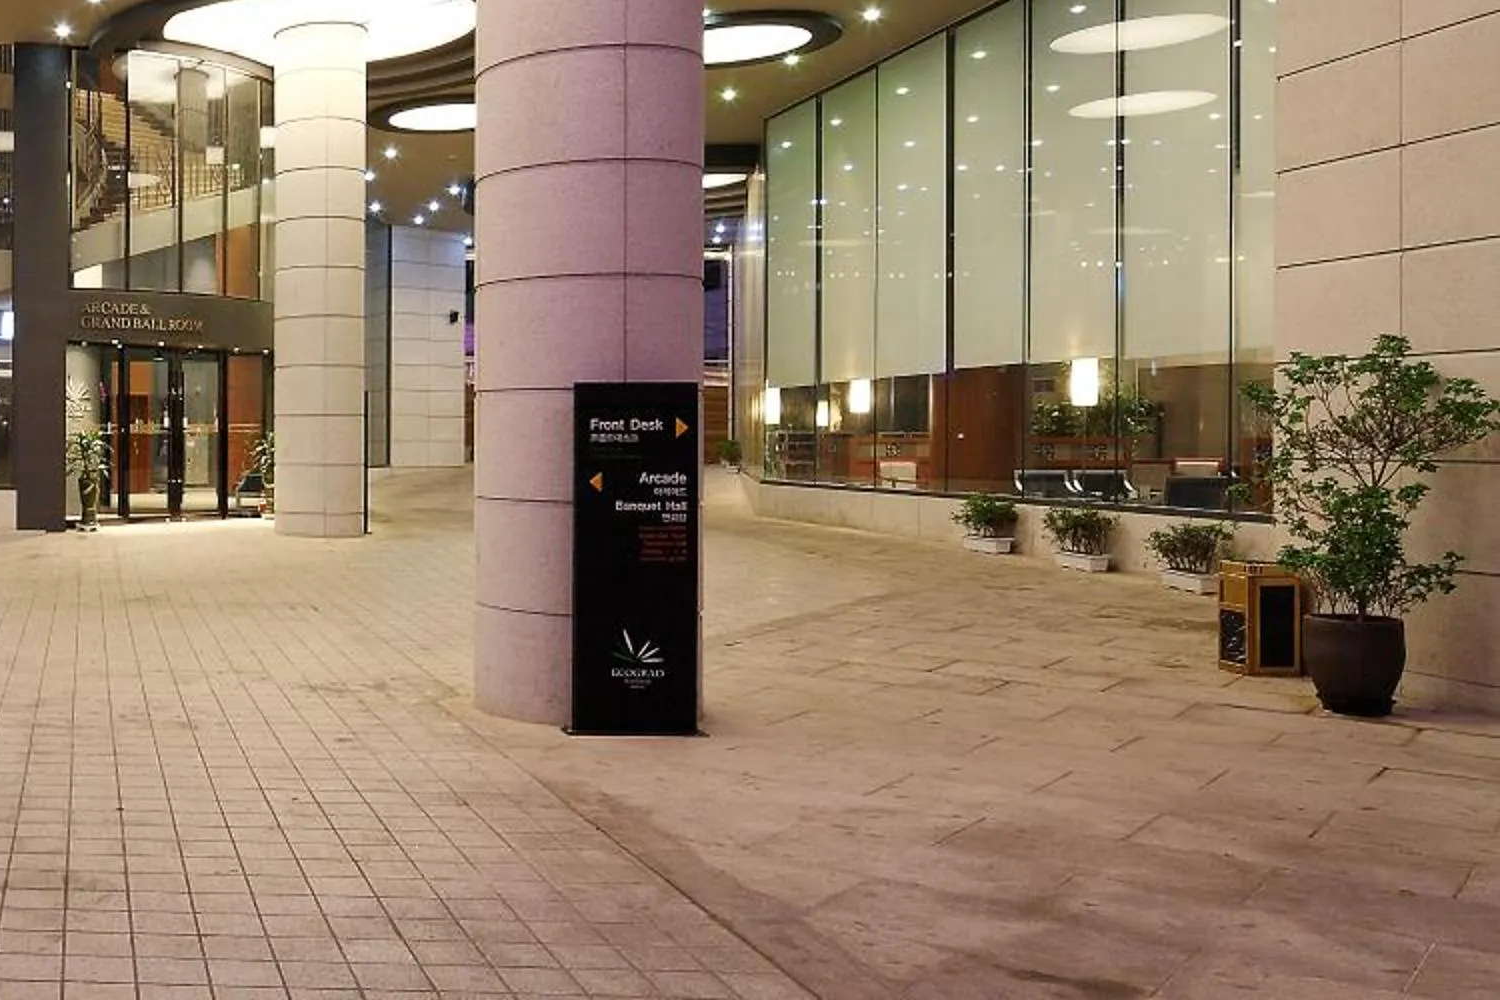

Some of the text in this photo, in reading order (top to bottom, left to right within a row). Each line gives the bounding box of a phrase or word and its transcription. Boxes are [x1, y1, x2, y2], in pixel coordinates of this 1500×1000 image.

[81, 301, 151, 316] ARCADE &
[81, 316, 131, 329] GRAND
[590, 418, 664, 431] Front Desk
[639, 472, 687, 485] Arcade
[615, 500, 688, 513] Banquet Hall
